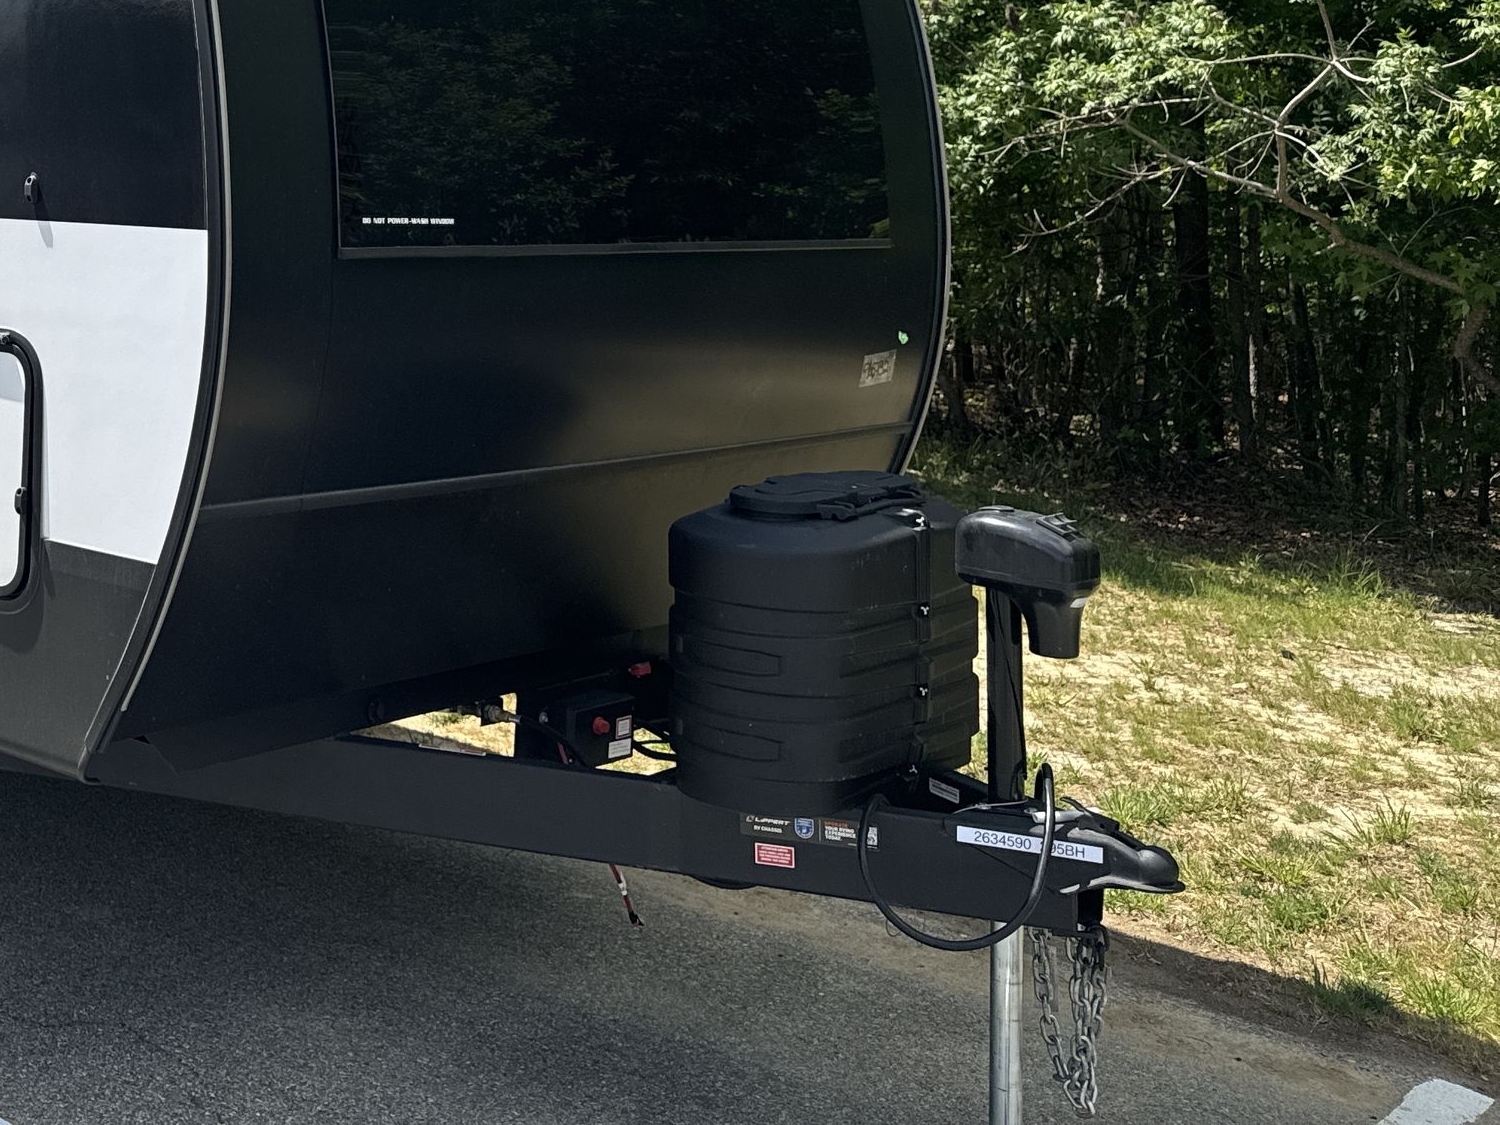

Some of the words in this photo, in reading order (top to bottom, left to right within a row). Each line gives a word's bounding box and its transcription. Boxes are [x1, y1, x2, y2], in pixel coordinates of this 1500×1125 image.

[754, 816, 791, 826] LIPPERT
[974, 830, 1032, 850] 2634590
[1039, 839, 1086, 859] 95BH
